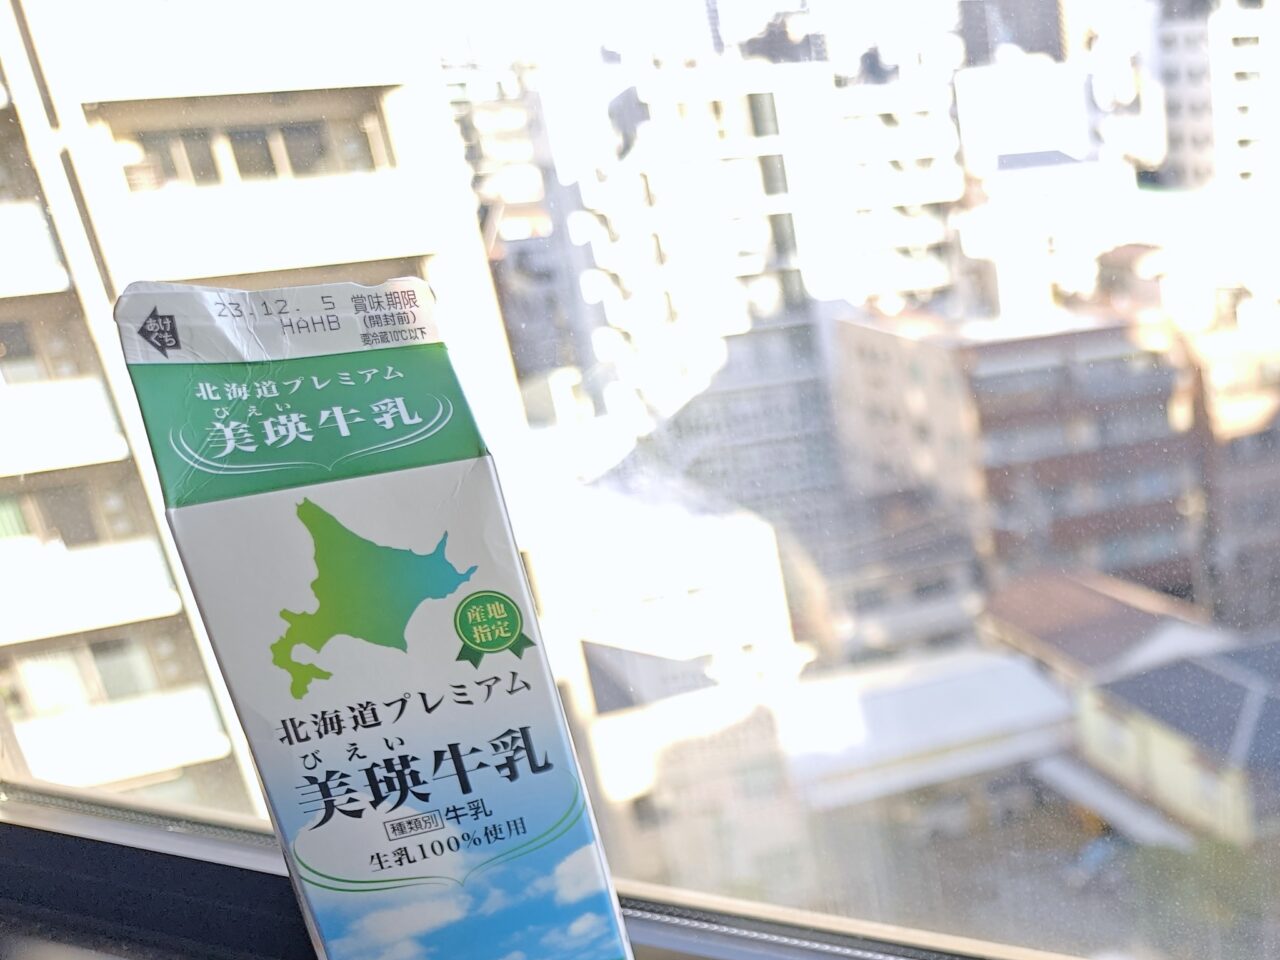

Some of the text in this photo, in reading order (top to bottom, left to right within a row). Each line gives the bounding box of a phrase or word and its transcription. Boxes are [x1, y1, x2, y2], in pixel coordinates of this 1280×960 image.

[321, 295, 336, 312] 5
[350, 290, 420, 315] 賞味期限
[146, 317, 172, 332] あけ
[279, 314, 341, 336] HAHB
[150, 332, 176, 347] ぐち
[194, 365, 405, 402] 北海道プレミアム
[207, 396, 422, 459] 美瑛牛乳
[467, 601, 509, 623] 産地
[471, 620, 513, 645] 指定
[275, 671, 532, 747] 北海道プレミアム
[295, 725, 554, 831] 美瑛牛乳
[390, 798, 493, 838] 種類別 牛乳
[369, 816, 528, 873] 生乳100%使用
